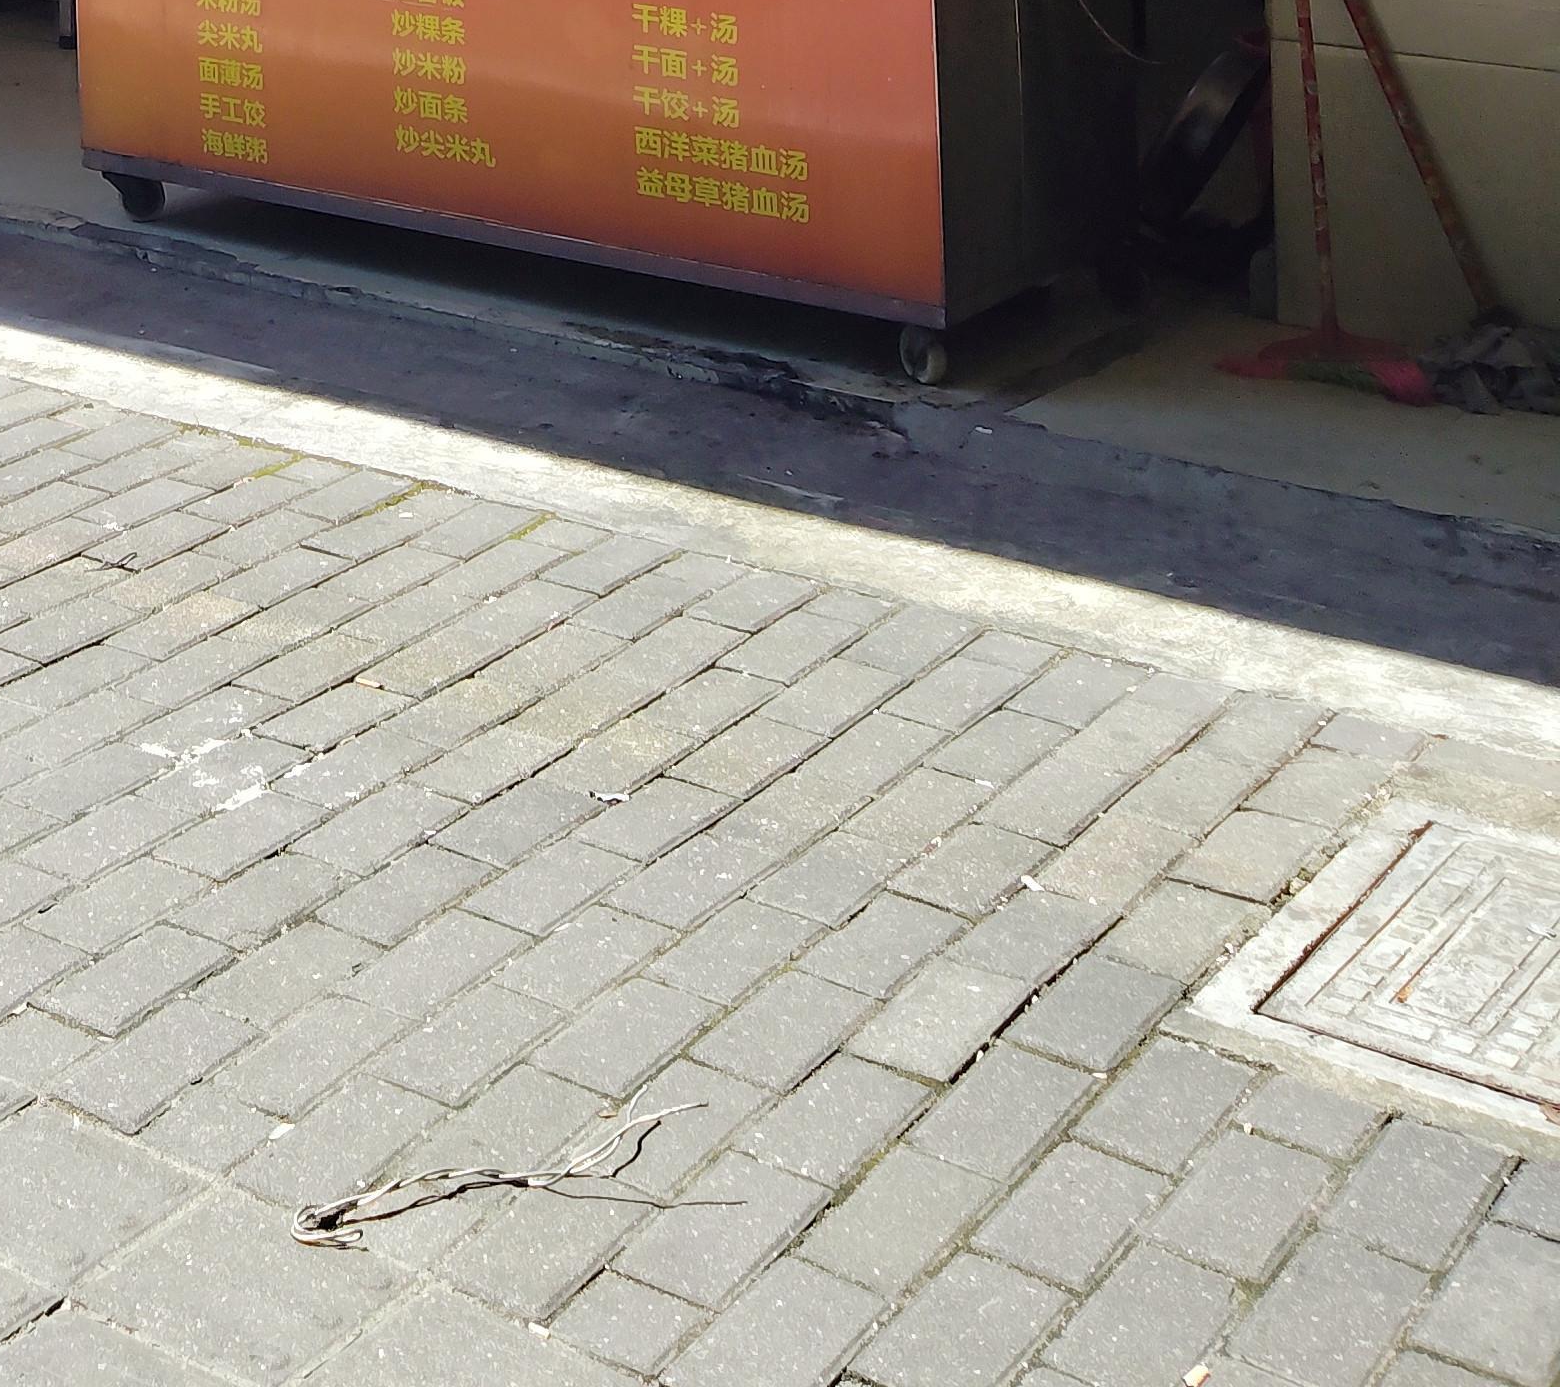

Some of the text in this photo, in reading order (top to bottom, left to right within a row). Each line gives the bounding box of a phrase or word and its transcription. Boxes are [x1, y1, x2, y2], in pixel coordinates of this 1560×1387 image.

[197, 19, 263, 54] 尖米丸
[392, 9, 465, 45] 炒粿条
[632, 3, 738, 44] 干粿+汤
[198, 57, 264, 91] 面薄汤
[392, 47, 466, 85] 炒米粉
[632, 44, 739, 87] 干面+汤
[200, 92, 267, 128] 手工饺
[393, 86, 468, 124] 炒面条
[633, 85, 740, 128] 干饺+汤
[201, 128, 268, 164] 海鲜粥
[395, 123, 496, 167] 炒尖米丸
[634, 126, 808, 181] 西洋菜猪血汤
[636, 166, 809, 224] 益母草猪血汤
